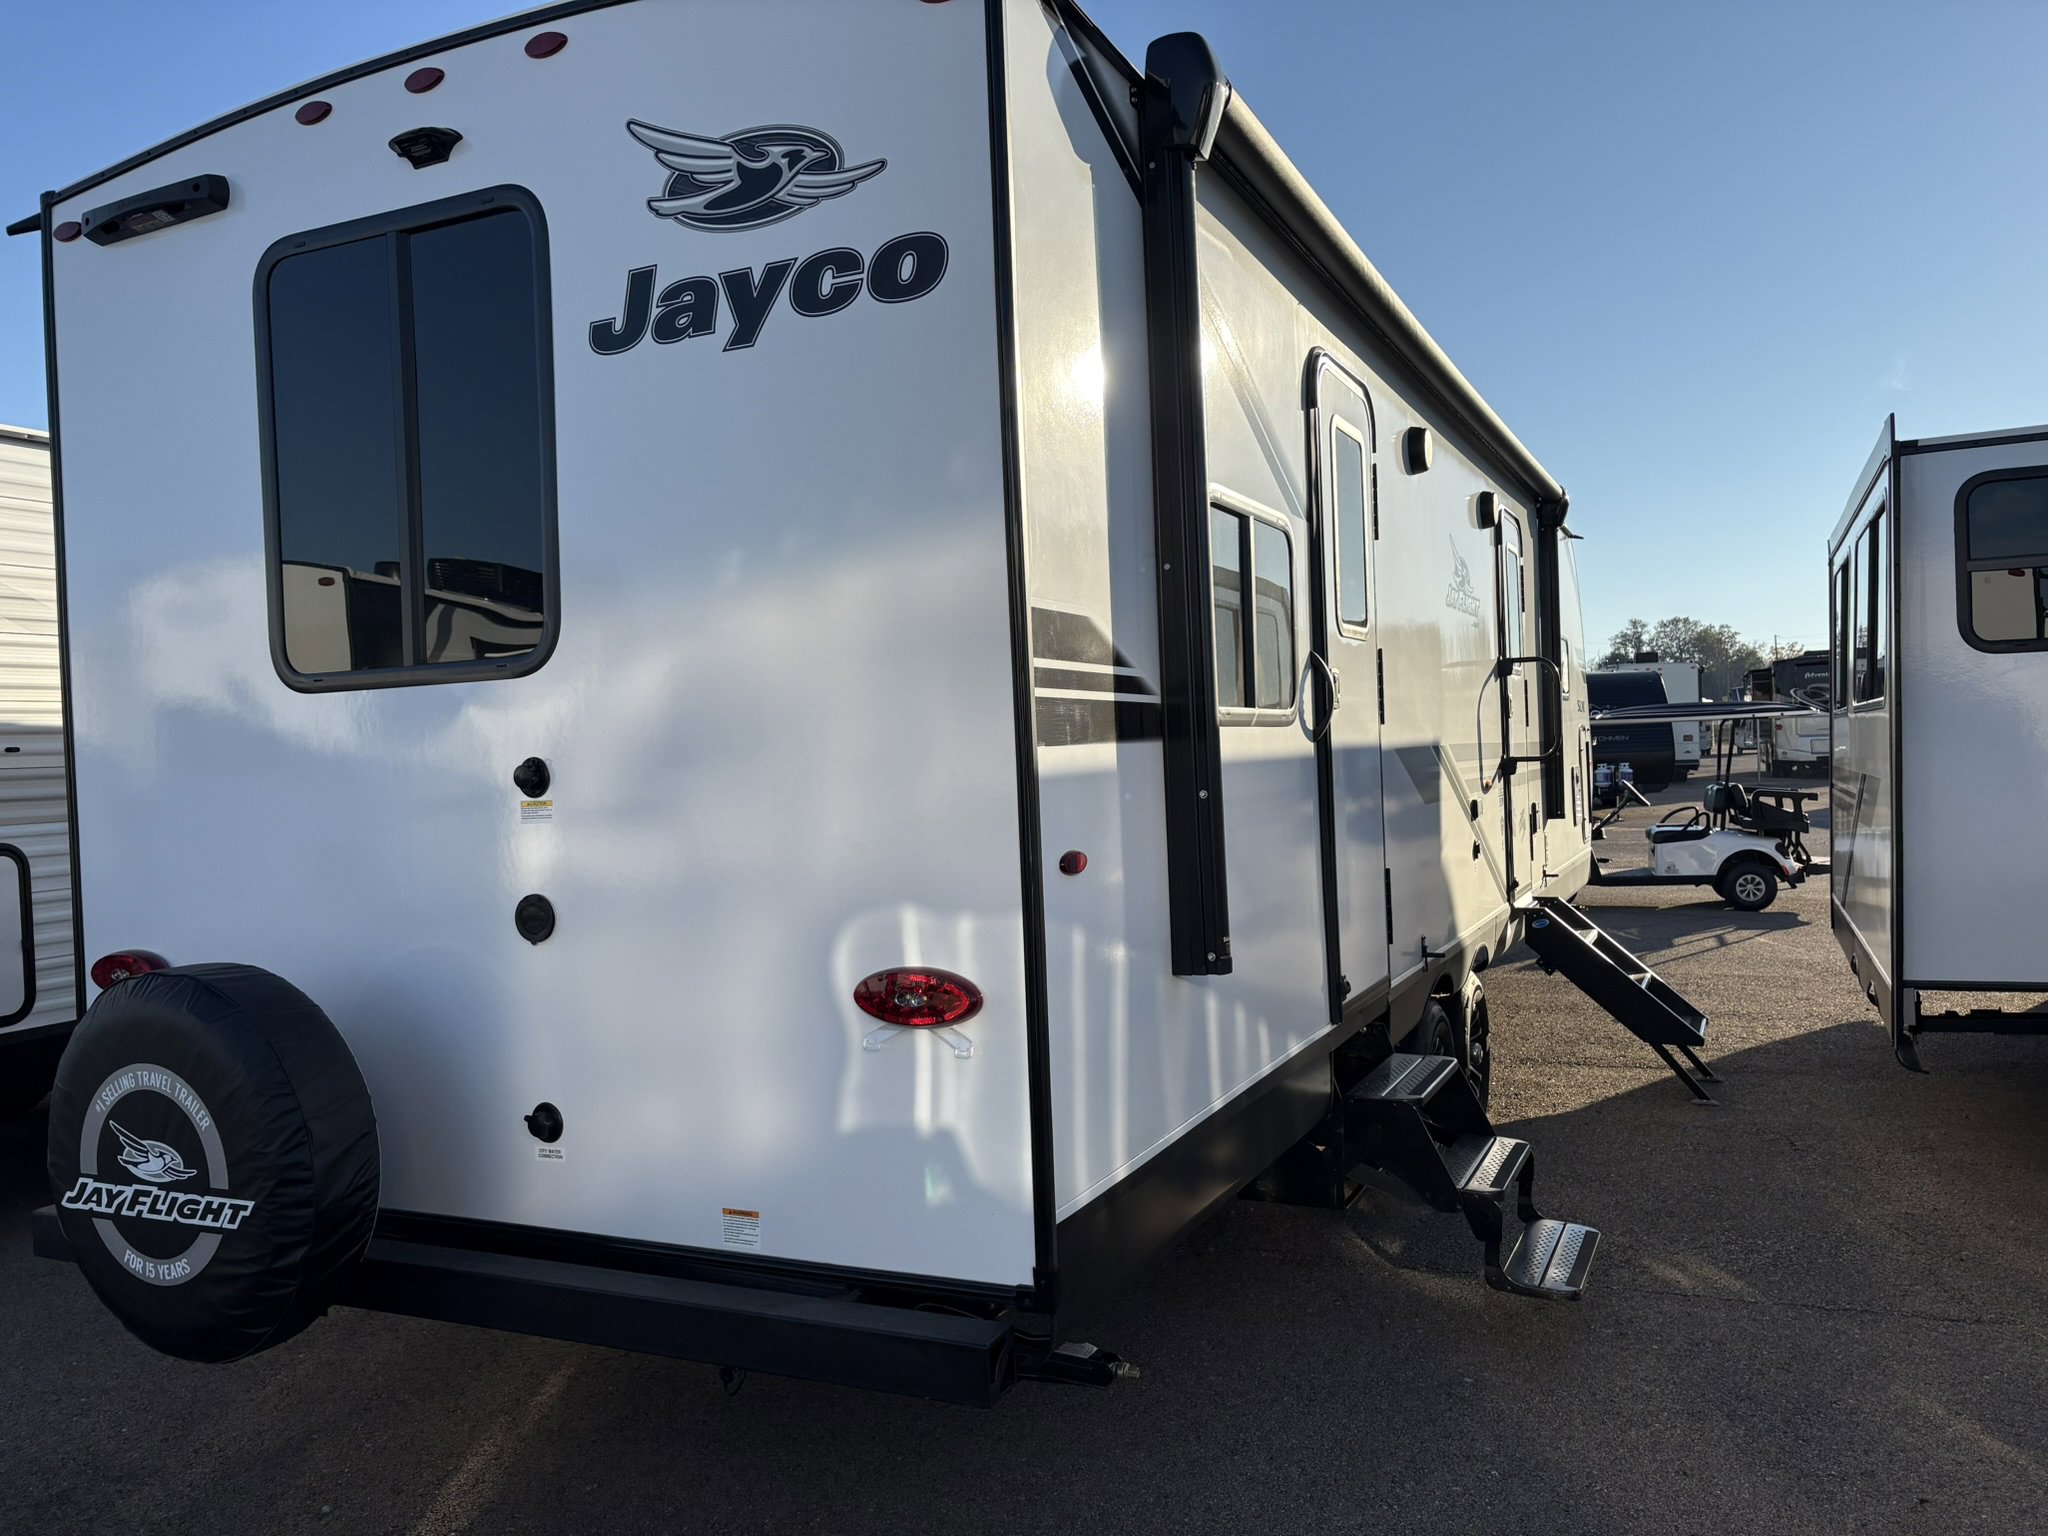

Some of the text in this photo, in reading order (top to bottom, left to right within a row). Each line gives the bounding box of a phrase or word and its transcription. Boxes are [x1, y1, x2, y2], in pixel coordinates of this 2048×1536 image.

[588, 231, 949, 355] Jayco
[102, 1072, 135, 1105] SELLING
[136, 1071, 171, 1093] TRAVEL
[174, 1083, 210, 1131] TRAILER
[124, 1249, 191, 1280] FOR 15 YEARS
